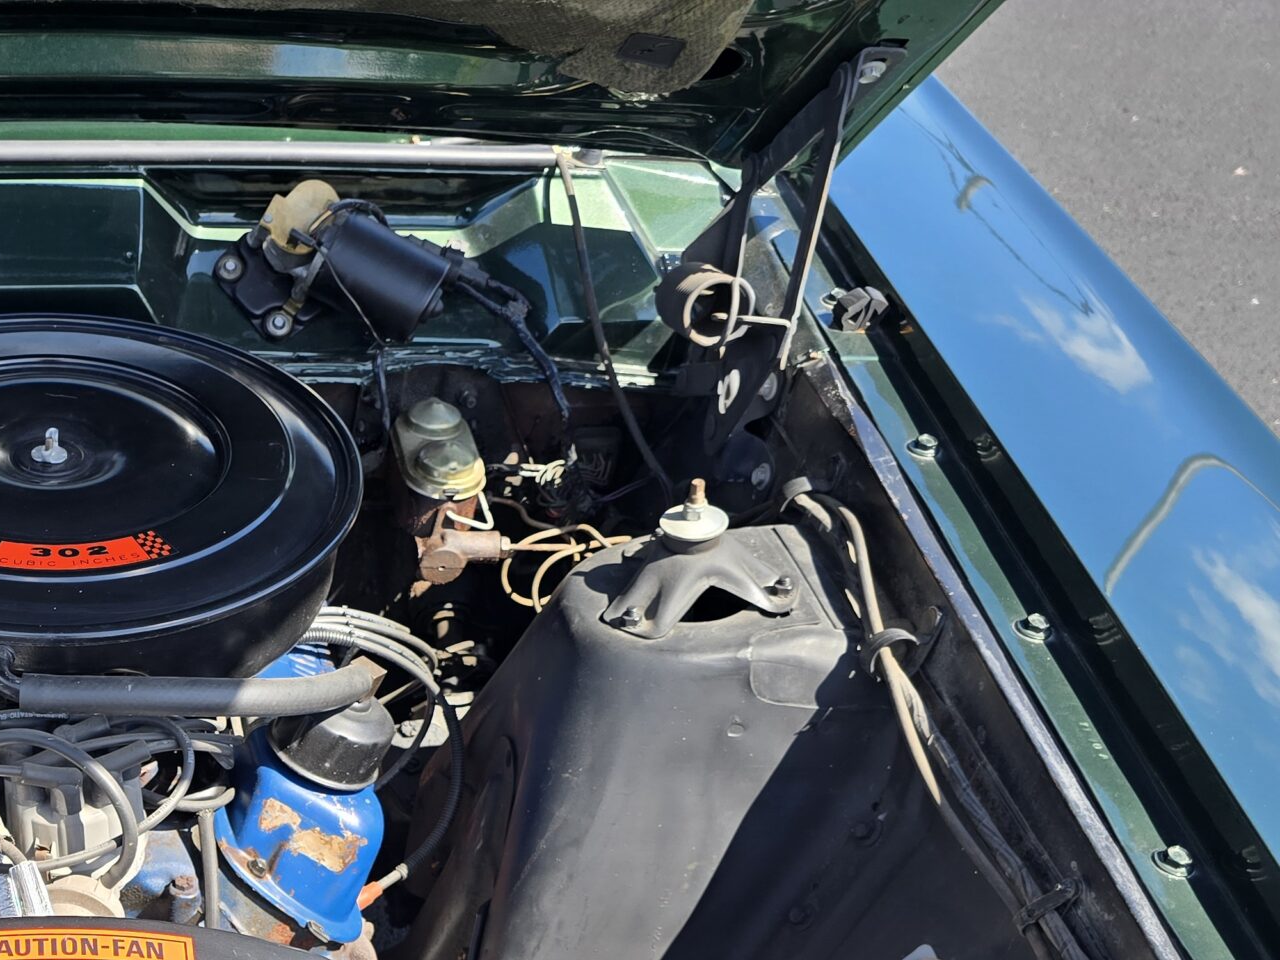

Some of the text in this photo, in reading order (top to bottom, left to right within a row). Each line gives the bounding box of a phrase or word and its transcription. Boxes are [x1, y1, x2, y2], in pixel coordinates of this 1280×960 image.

[30, 545, 109, 558] 302
[0, 552, 141, 567] CUBIC INCHES
